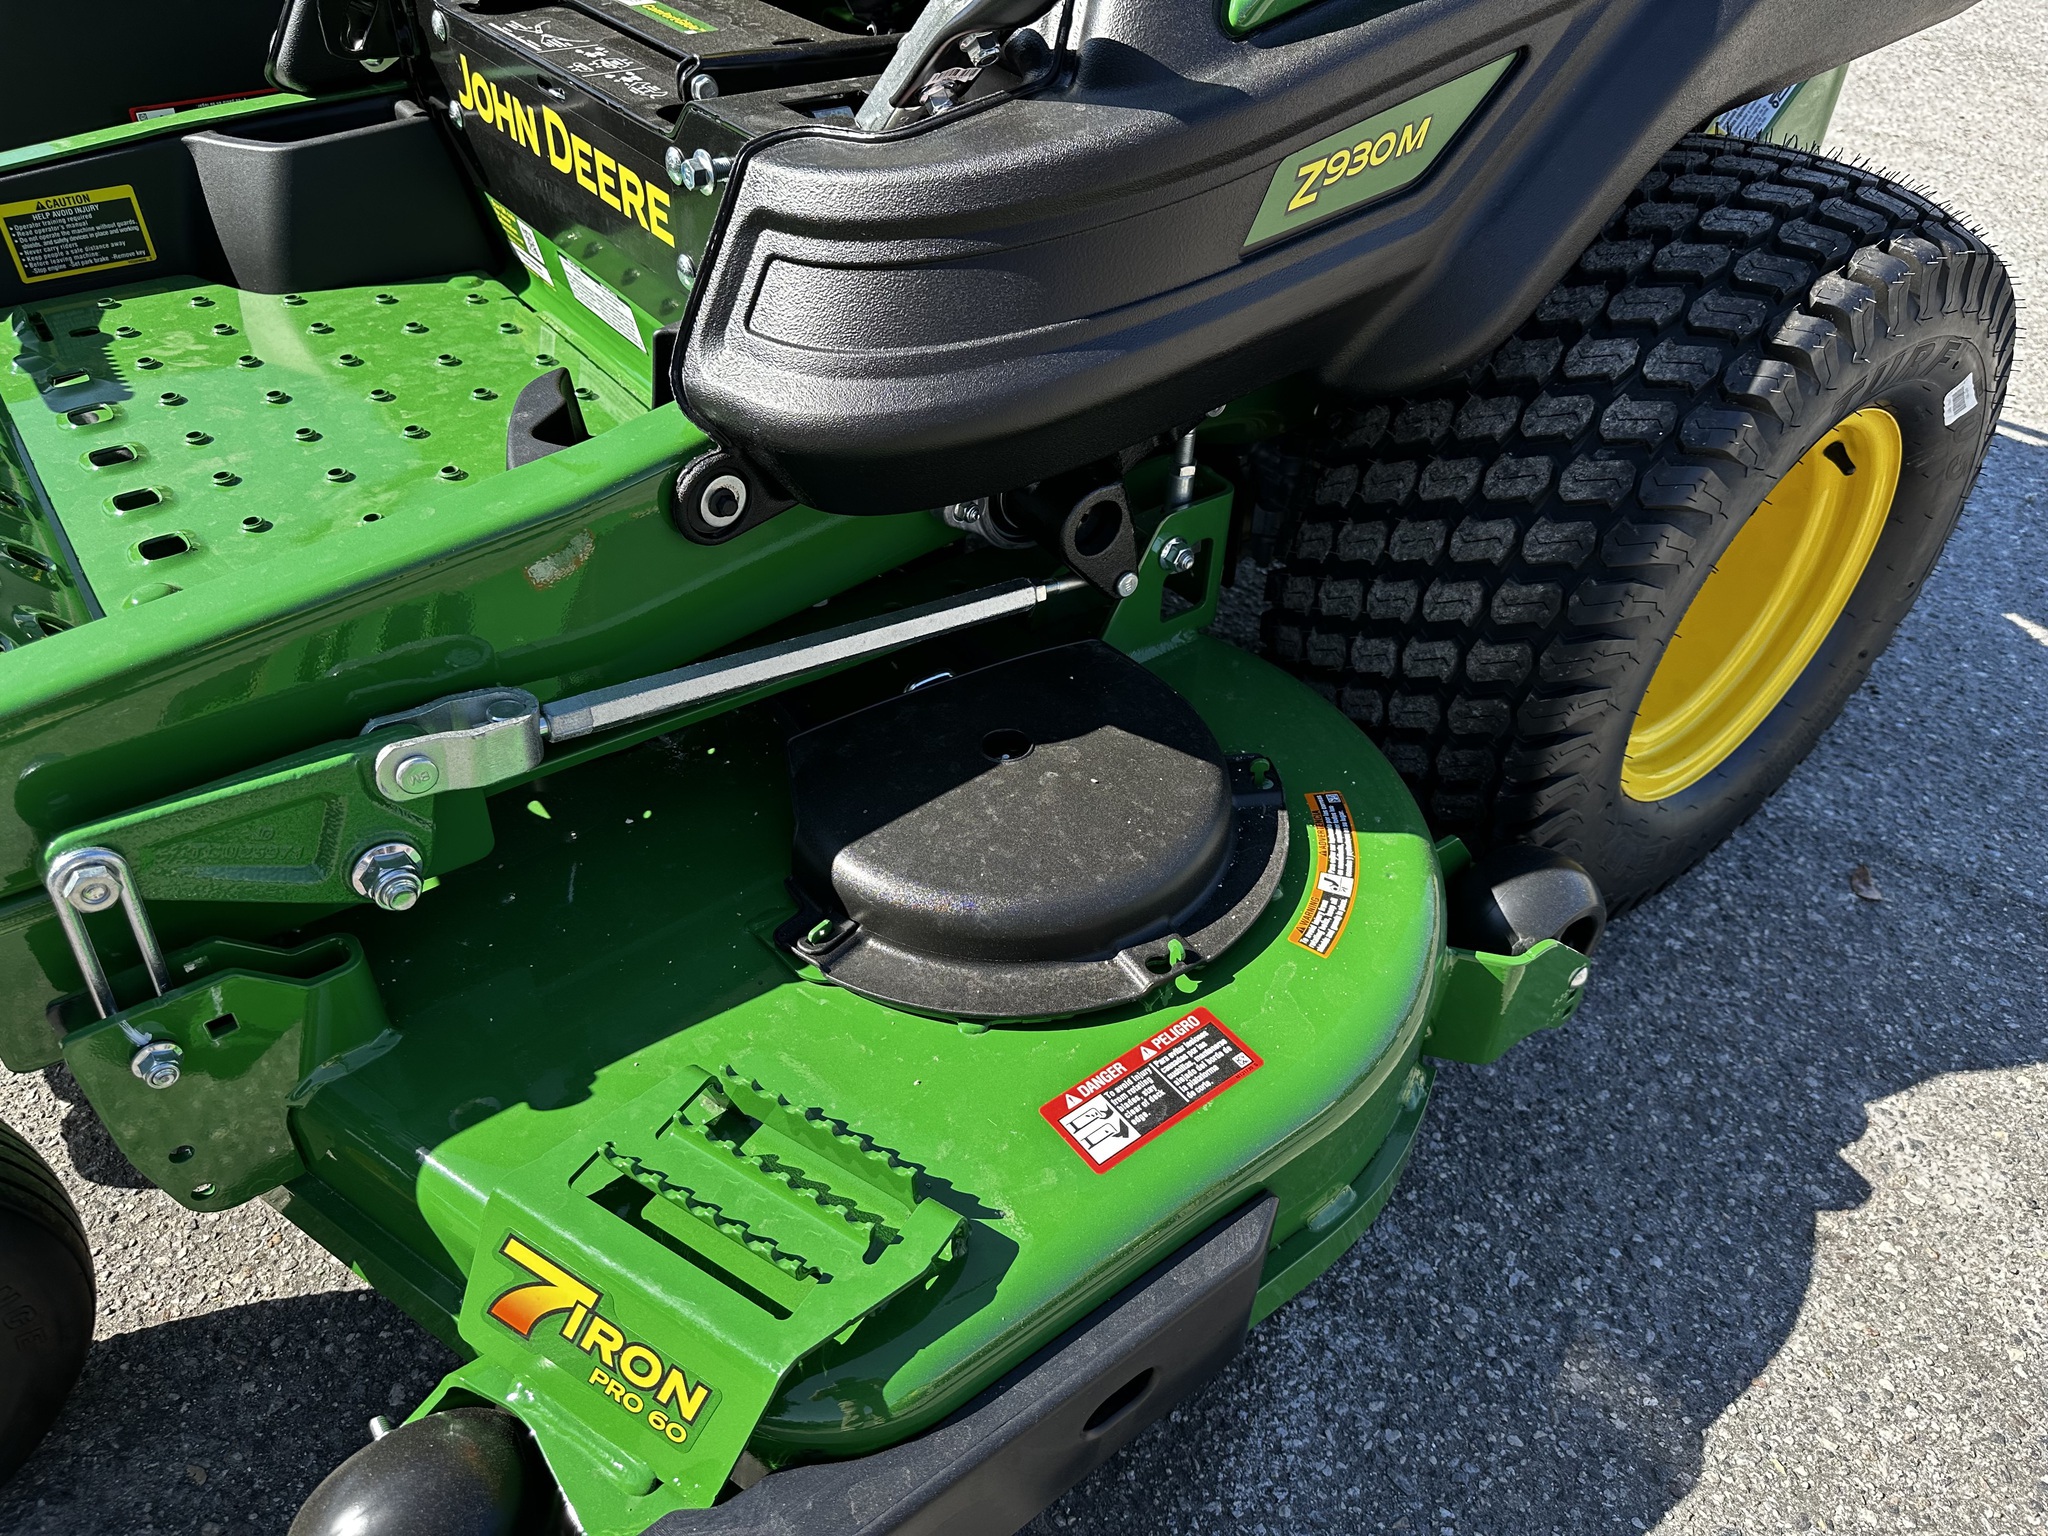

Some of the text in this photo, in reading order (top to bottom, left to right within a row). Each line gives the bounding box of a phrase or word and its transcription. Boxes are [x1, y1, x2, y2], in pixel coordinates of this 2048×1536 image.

[458, 53, 541, 158] JOHN
[542, 104, 676, 249] DEERE
[1287, 115, 1433, 214] Z930M
[31, 204, 100, 220] HELP AVOID INJURY
[44, 193, 91, 208] CAUTION
[13, 213, 93, 230] Operator training required
[33, 224, 65, 234] operator's
[65, 220, 88, 228] manual
[38, 231, 60, 240] operate
[70, 225, 95, 234] machine
[95, 222, 116, 230] without
[52, 236, 69, 244] safety
[68, 233, 89, 241] devices
[118, 224, 139, 233] working
[23, 241, 78, 255] Never carry riders
[26, 254, 42, 262] Keep
[42, 250, 64, 259] people
[83, 242, 110, 251] distance
[29, 260, 49, 268] Before
[49, 255, 73, 265] leaving
[1311, 810, 1327, 850] ADVERTENCIA
[1299, 896, 1319, 927] WARNING
[1150, 1014, 1201, 1050] PELIGRO
[1152, 1029, 1209, 1068] Para evitar lesiones
[1159, 1040, 1208, 1074] causadas por las
[1165, 1037, 1228, 1080] cuchillas, mantenerse
[1076, 1061, 1128, 1097] DANGER
[1172, 1044, 1233, 1087] alejado del borde de
[1179, 1063, 1220, 1093] la plataforma
[1103, 1065, 1153, 1099] To avoid injury
[1110, 1075, 1154, 1106] from rotating
[1185, 1078, 1214, 1099] de corte.
[1117, 1083, 1159, 1113] blades, stay
[1123, 1088, 1166, 1119] clear of deck
[1130, 1109, 1151, 1125] edge.
[588, 1366, 688, 1444] PRO 60
